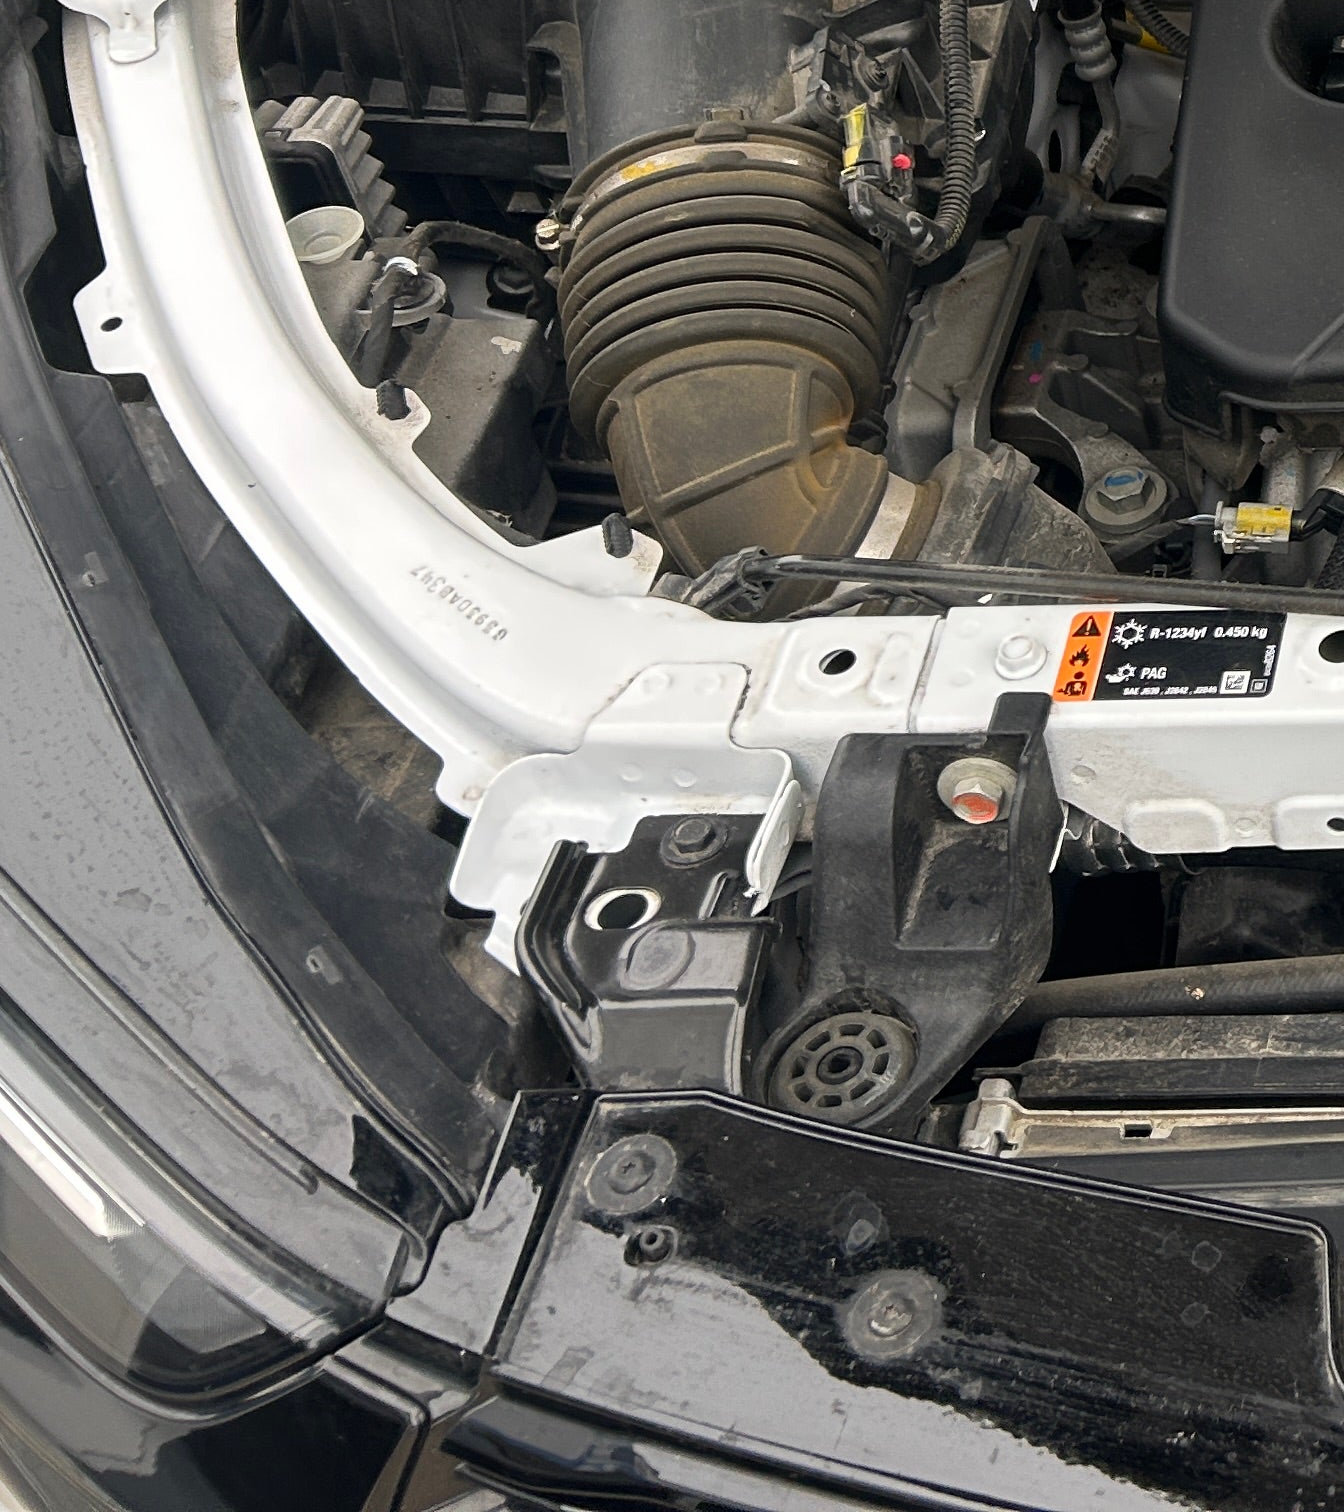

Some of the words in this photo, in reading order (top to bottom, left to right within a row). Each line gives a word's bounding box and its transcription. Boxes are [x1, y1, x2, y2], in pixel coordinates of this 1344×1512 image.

[1149, 626, 1207, 640] R-1234yf
[1213, 626, 1249, 638] 0.450
[1250, 626, 1268, 639] kg
[1140, 667, 1167, 680] PAG
